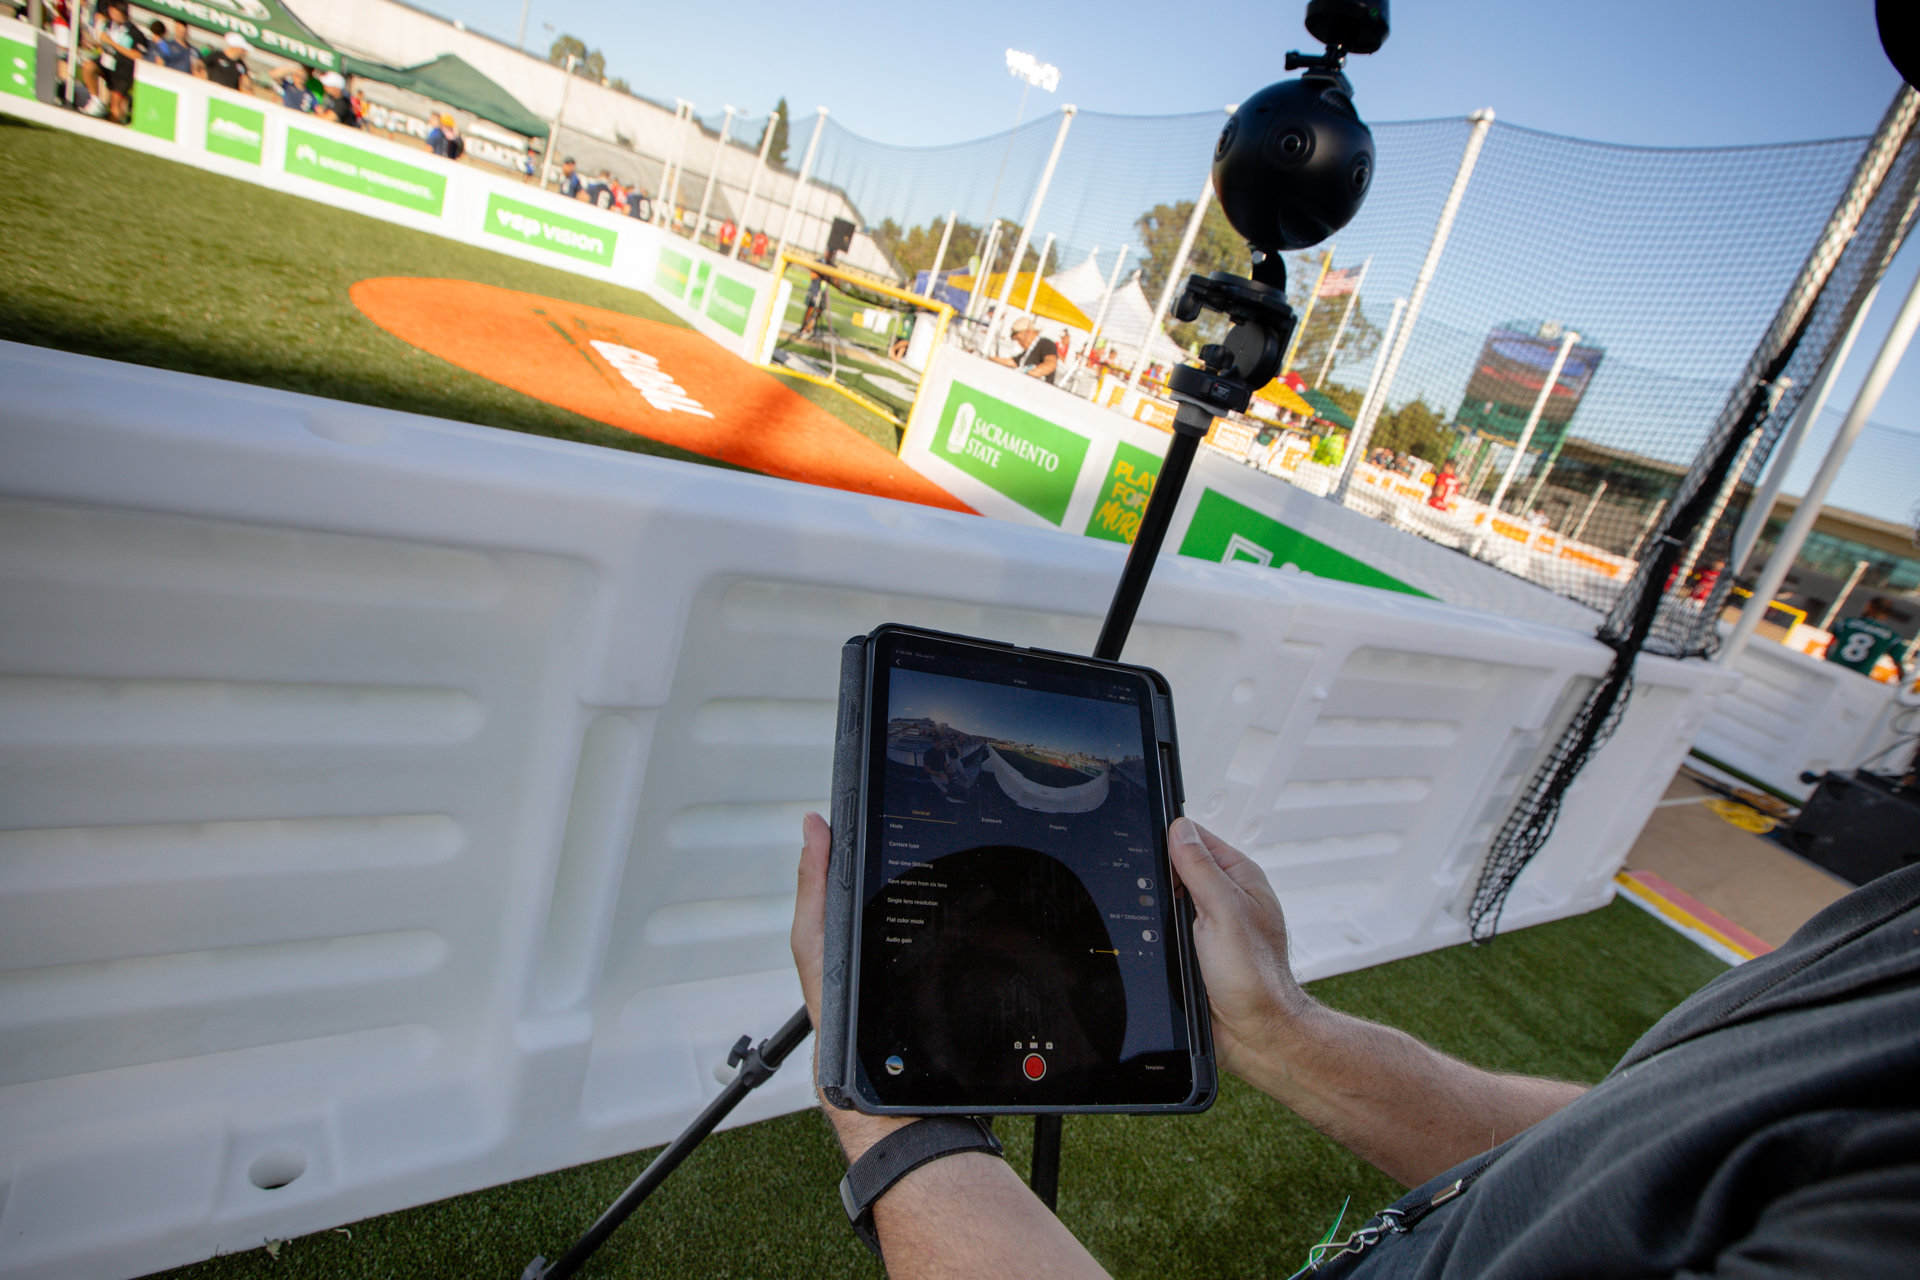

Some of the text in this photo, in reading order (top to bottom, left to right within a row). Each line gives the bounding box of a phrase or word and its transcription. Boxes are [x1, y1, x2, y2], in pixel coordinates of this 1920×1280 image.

[260, 28, 335, 67] STATE
[972, 417, 1059, 472] SACRAMENTO
[965, 437, 1002, 469] STATE
[1840, 632, 1876, 663] 8
[1013, 678, 1028, 686] Video
[981, 817, 1002, 825] Exposure
[1049, 824, 1067, 832] Property
[888, 859, 934, 869] Real-time Stitching
[900, 879, 917, 887] origins
[887, 897, 903, 905] Single
[901, 937, 913, 945] gain
